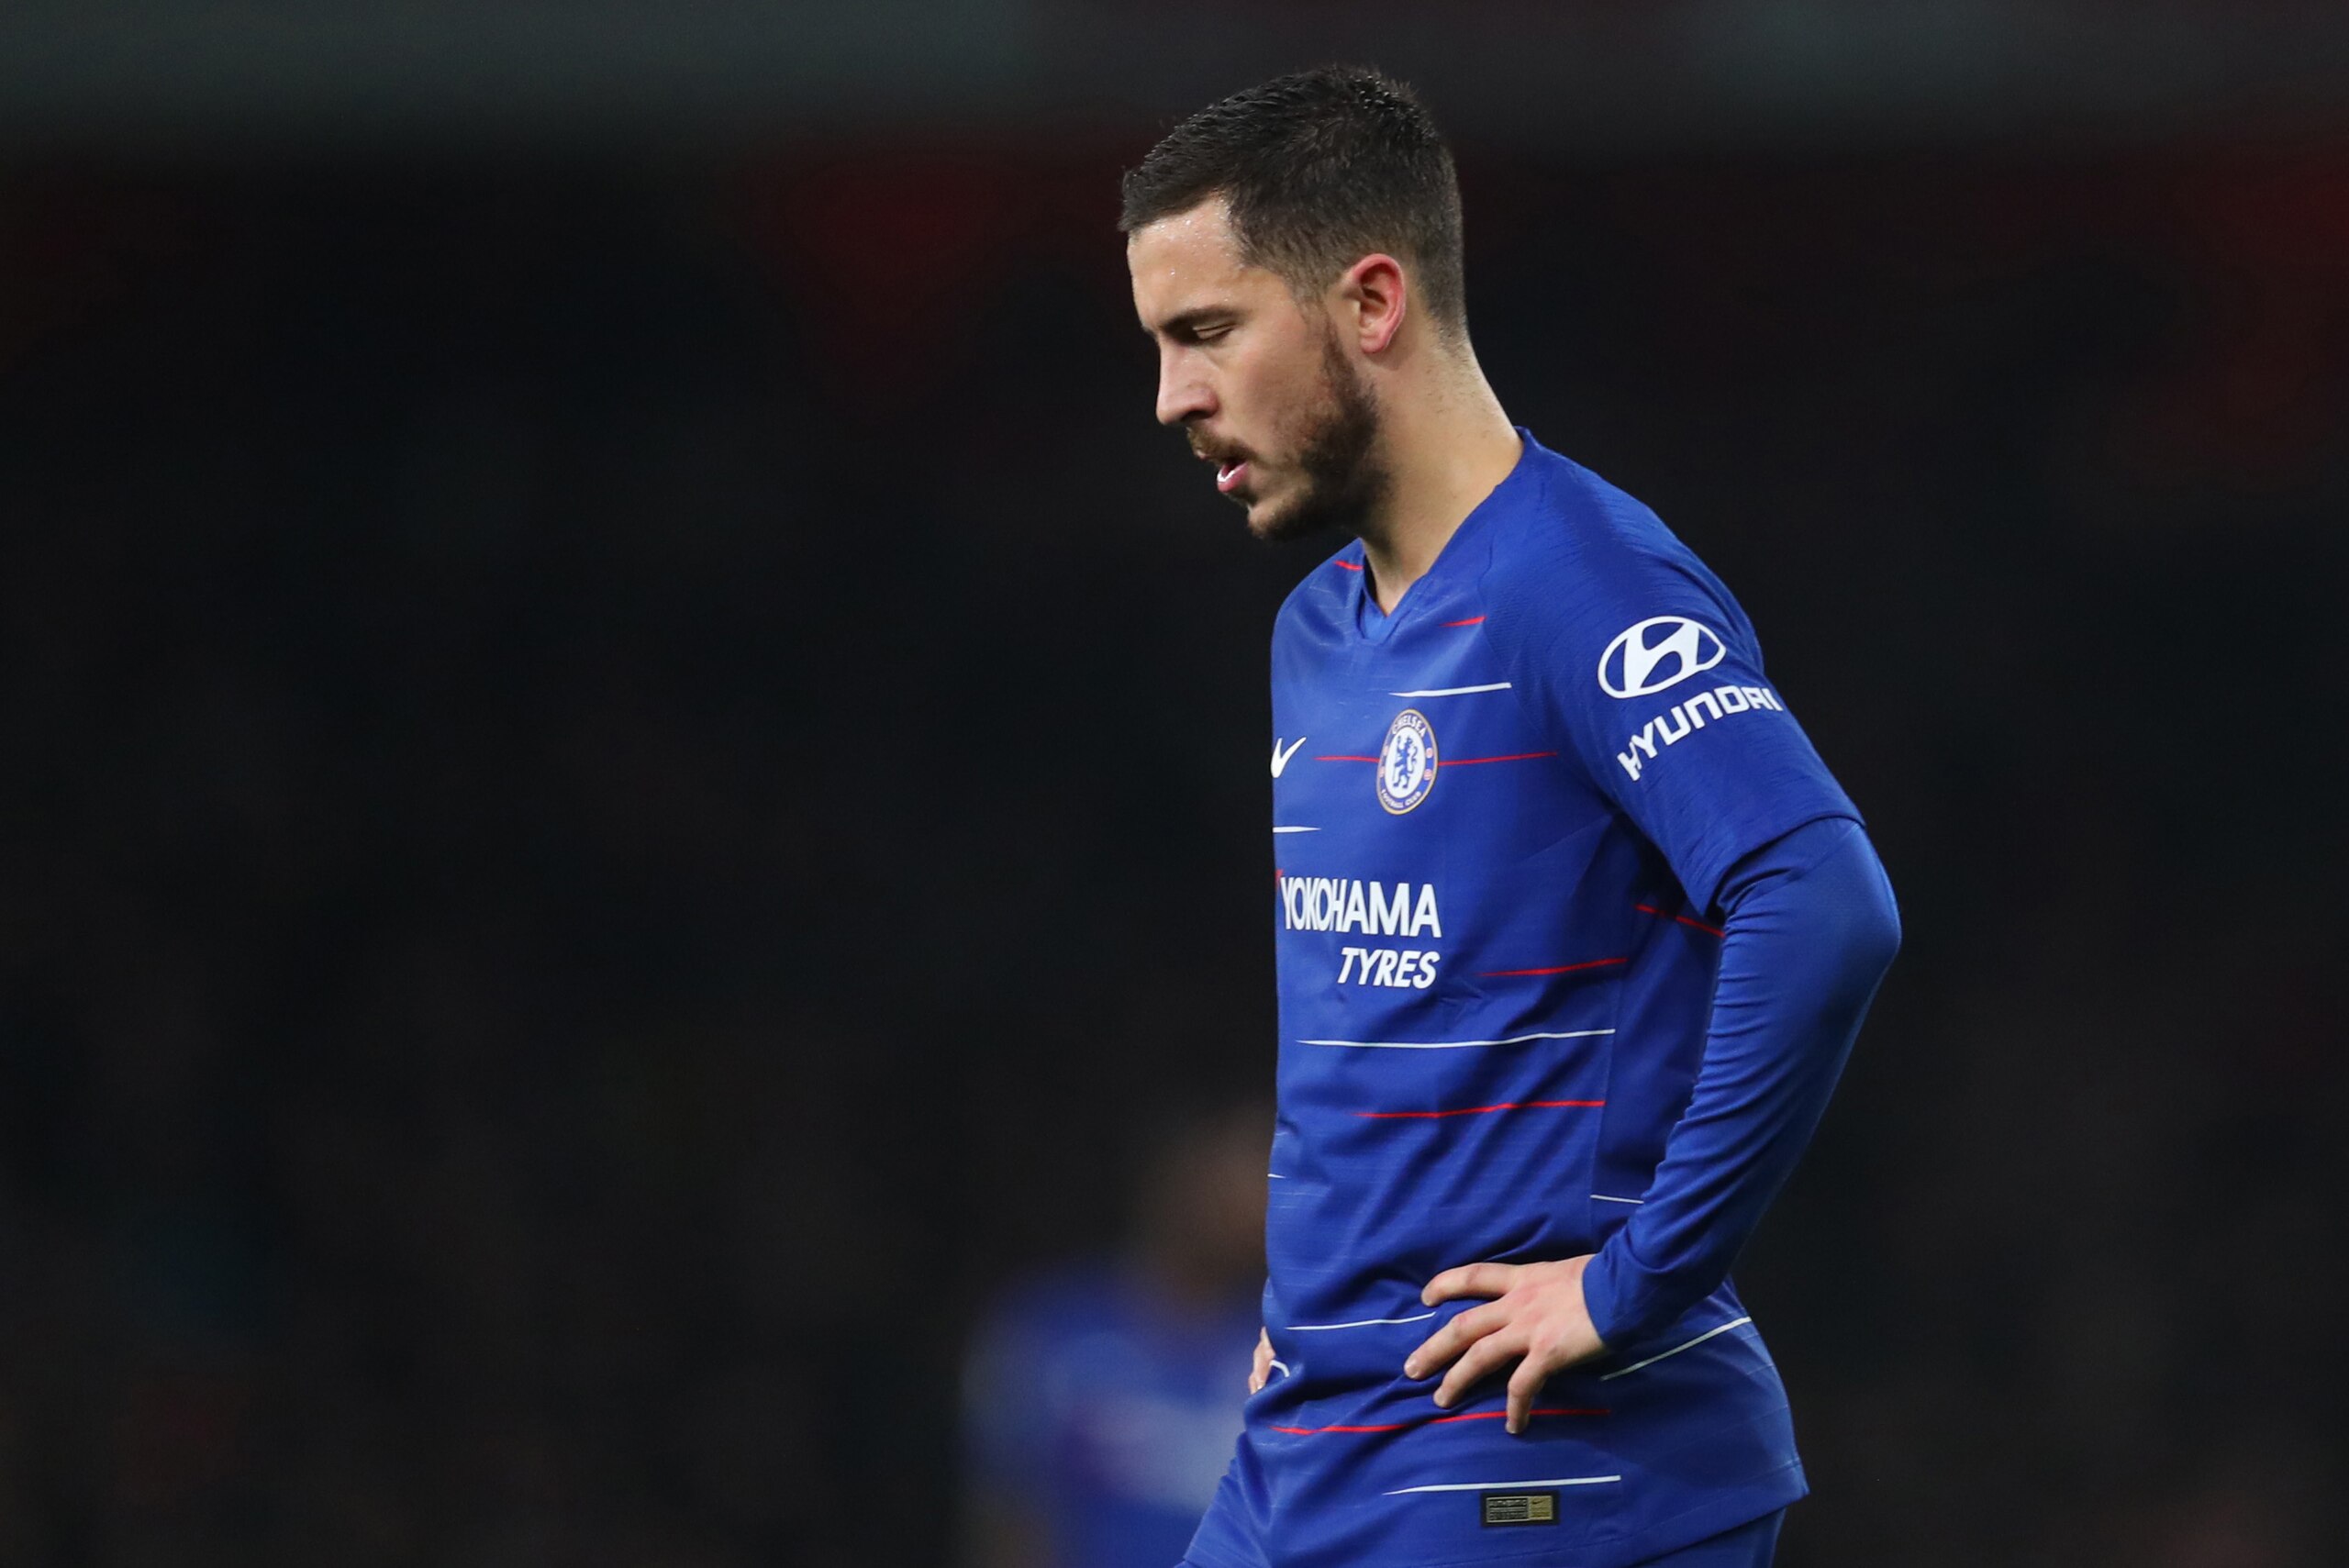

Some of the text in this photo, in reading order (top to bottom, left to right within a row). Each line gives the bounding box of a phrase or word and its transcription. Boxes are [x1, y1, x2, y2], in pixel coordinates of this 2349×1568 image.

[1617, 684, 1783, 782] HYUNDAI
[1280, 876, 1442, 938] YOKOHAMA
[1337, 947, 1441, 989] TYRES
